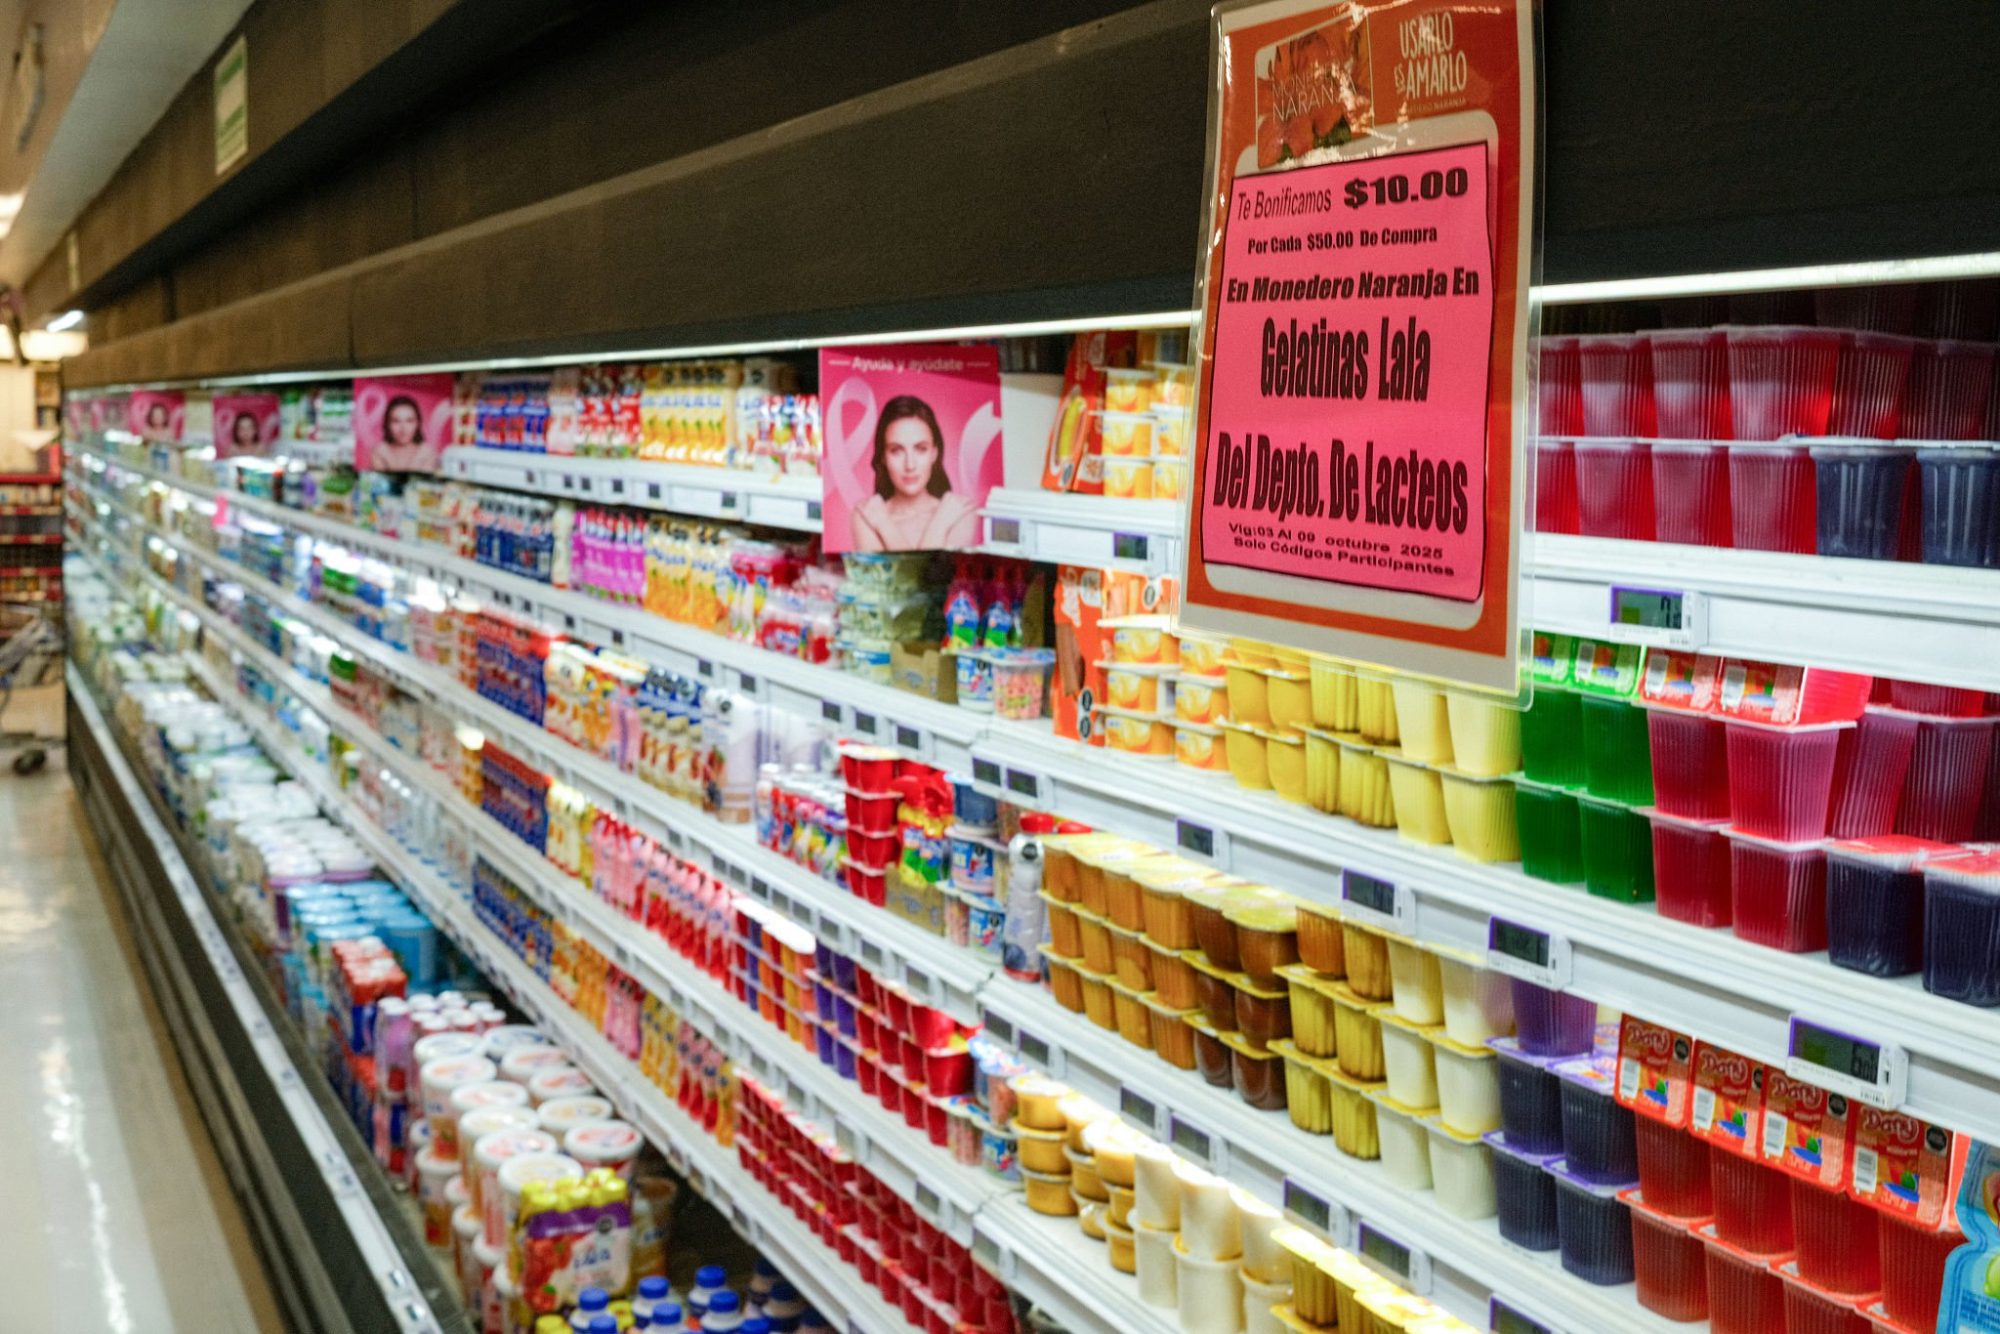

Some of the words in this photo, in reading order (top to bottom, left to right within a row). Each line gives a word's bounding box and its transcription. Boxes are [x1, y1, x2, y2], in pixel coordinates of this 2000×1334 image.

[1399, 12, 1453, 59] USARLO
[1406, 51, 1467, 99] AMARLO
[1237, 193, 1250, 220] Te
[1254, 187, 1331, 218] Bonificamos
[1344, 168, 1468, 209] $10.00
[1248, 239, 1267, 254] Por
[1270, 237, 1302, 253] Cada
[1307, 231, 1353, 250] $50.00
[1360, 231, 1377, 247] De
[1382, 227, 1437, 246] Compra
[1226, 278, 1248, 303] En
[1252, 274, 1353, 302] Monedero
[1359, 271, 1447, 300] Naranja
[1452, 267, 1479, 295] En
[1261, 317, 1368, 400] Gelatinas
[1378, 316, 1430, 402] Lala
[1213, 432, 1252, 509] Del
[1252, 434, 1324, 522] Depto.
[1329, 439, 1359, 522] De
[1365, 441, 1468, 535] Lacteos
[1234, 537, 1266, 550] Solo
[1338, 550, 1454, 576] Participantes
[1278, 527, 1291, 540] Al
[1325, 535, 1390, 552] octubre
